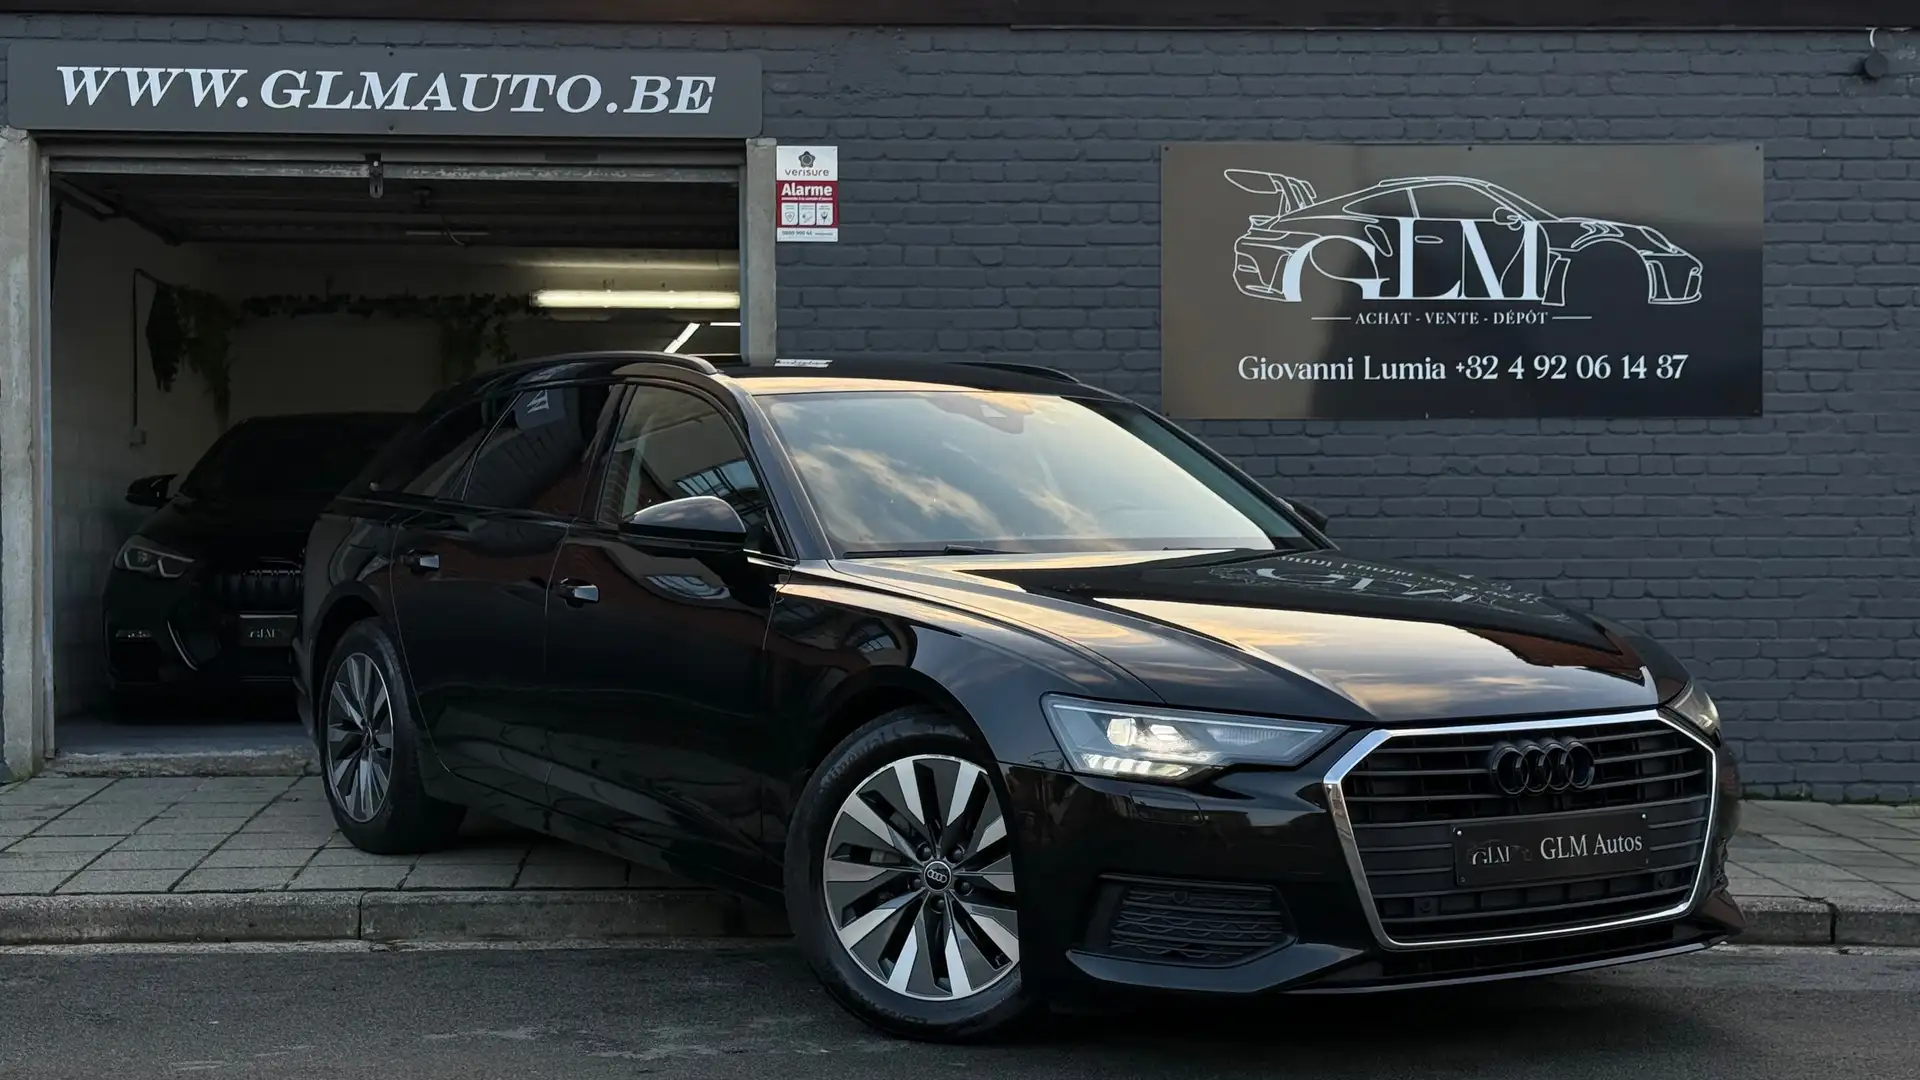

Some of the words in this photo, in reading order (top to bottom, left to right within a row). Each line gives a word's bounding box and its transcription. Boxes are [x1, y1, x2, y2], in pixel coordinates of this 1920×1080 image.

[56, 65, 717, 115] WWW.GLMAUTO.BE
[784, 169, 830, 177] verisure
[781, 182, 833, 196] Alarme
[1282, 217, 1546, 302] GLM
[1355, 312, 1412, 325] ACHAT
[1425, 312, 1479, 325] VENTE
[1493, 309, 1548, 325] DÉPÔT
[1238, 355, 1354, 380] Giovanni
[1364, 355, 1446, 380] Lumia
[1455, 355, 1499, 380] +32
[1507, 355, 1525, 380] 4
[1533, 355, 1567, 380] 92
[1576, 354, 1611, 379] 06
[1621, 354, 1647, 379] 14
[1656, 354, 1689, 379] 37
[1539, 834, 1588, 860] GLM
[1593, 833, 1643, 857] Autos
